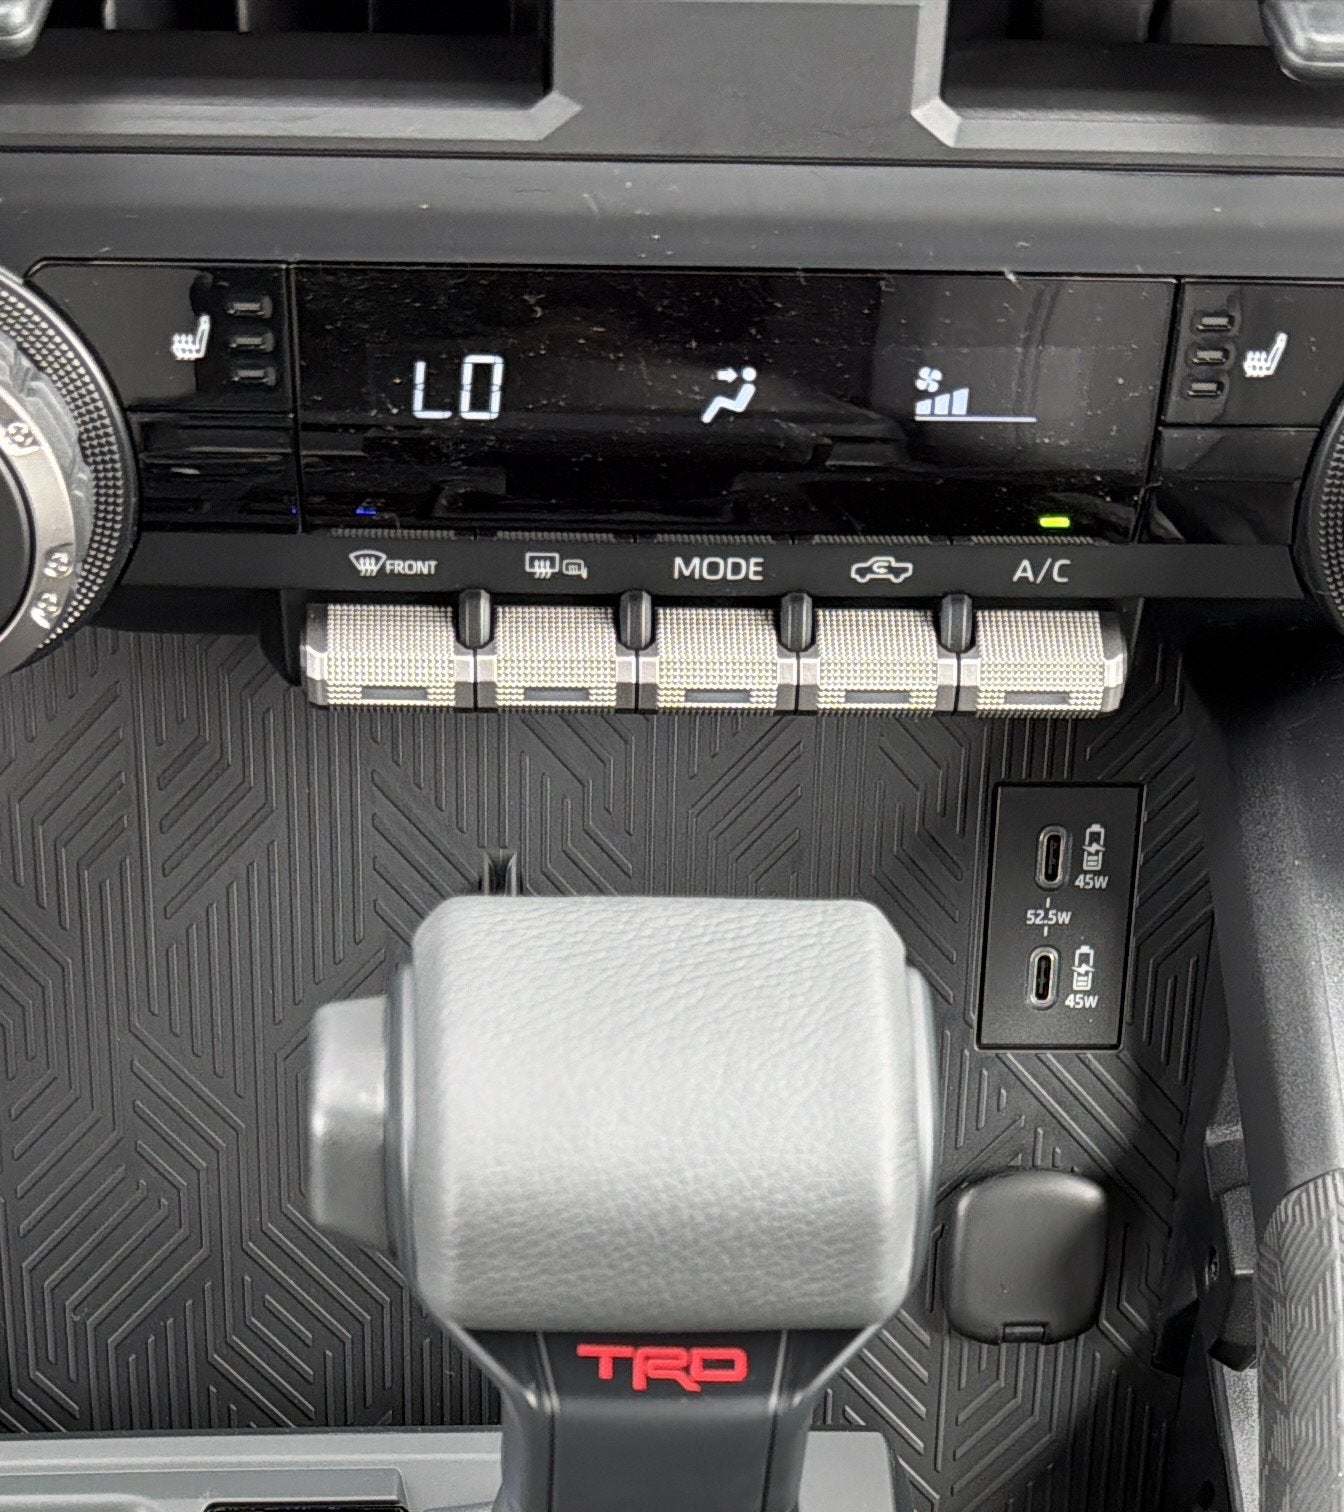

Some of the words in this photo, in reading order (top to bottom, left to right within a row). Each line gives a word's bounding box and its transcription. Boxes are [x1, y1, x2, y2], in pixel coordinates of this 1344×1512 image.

[412, 354, 505, 420] LO
[385, 559, 438, 576] FRONT
[672, 556, 765, 582] MODE
[1012, 557, 1072, 584] A/C
[1074, 873, 1109, 890] 45W
[1026, 909, 1072, 925] 52.5W
[1064, 994, 1099, 1009] 45W
[575, 1343, 749, 1393] TRD
